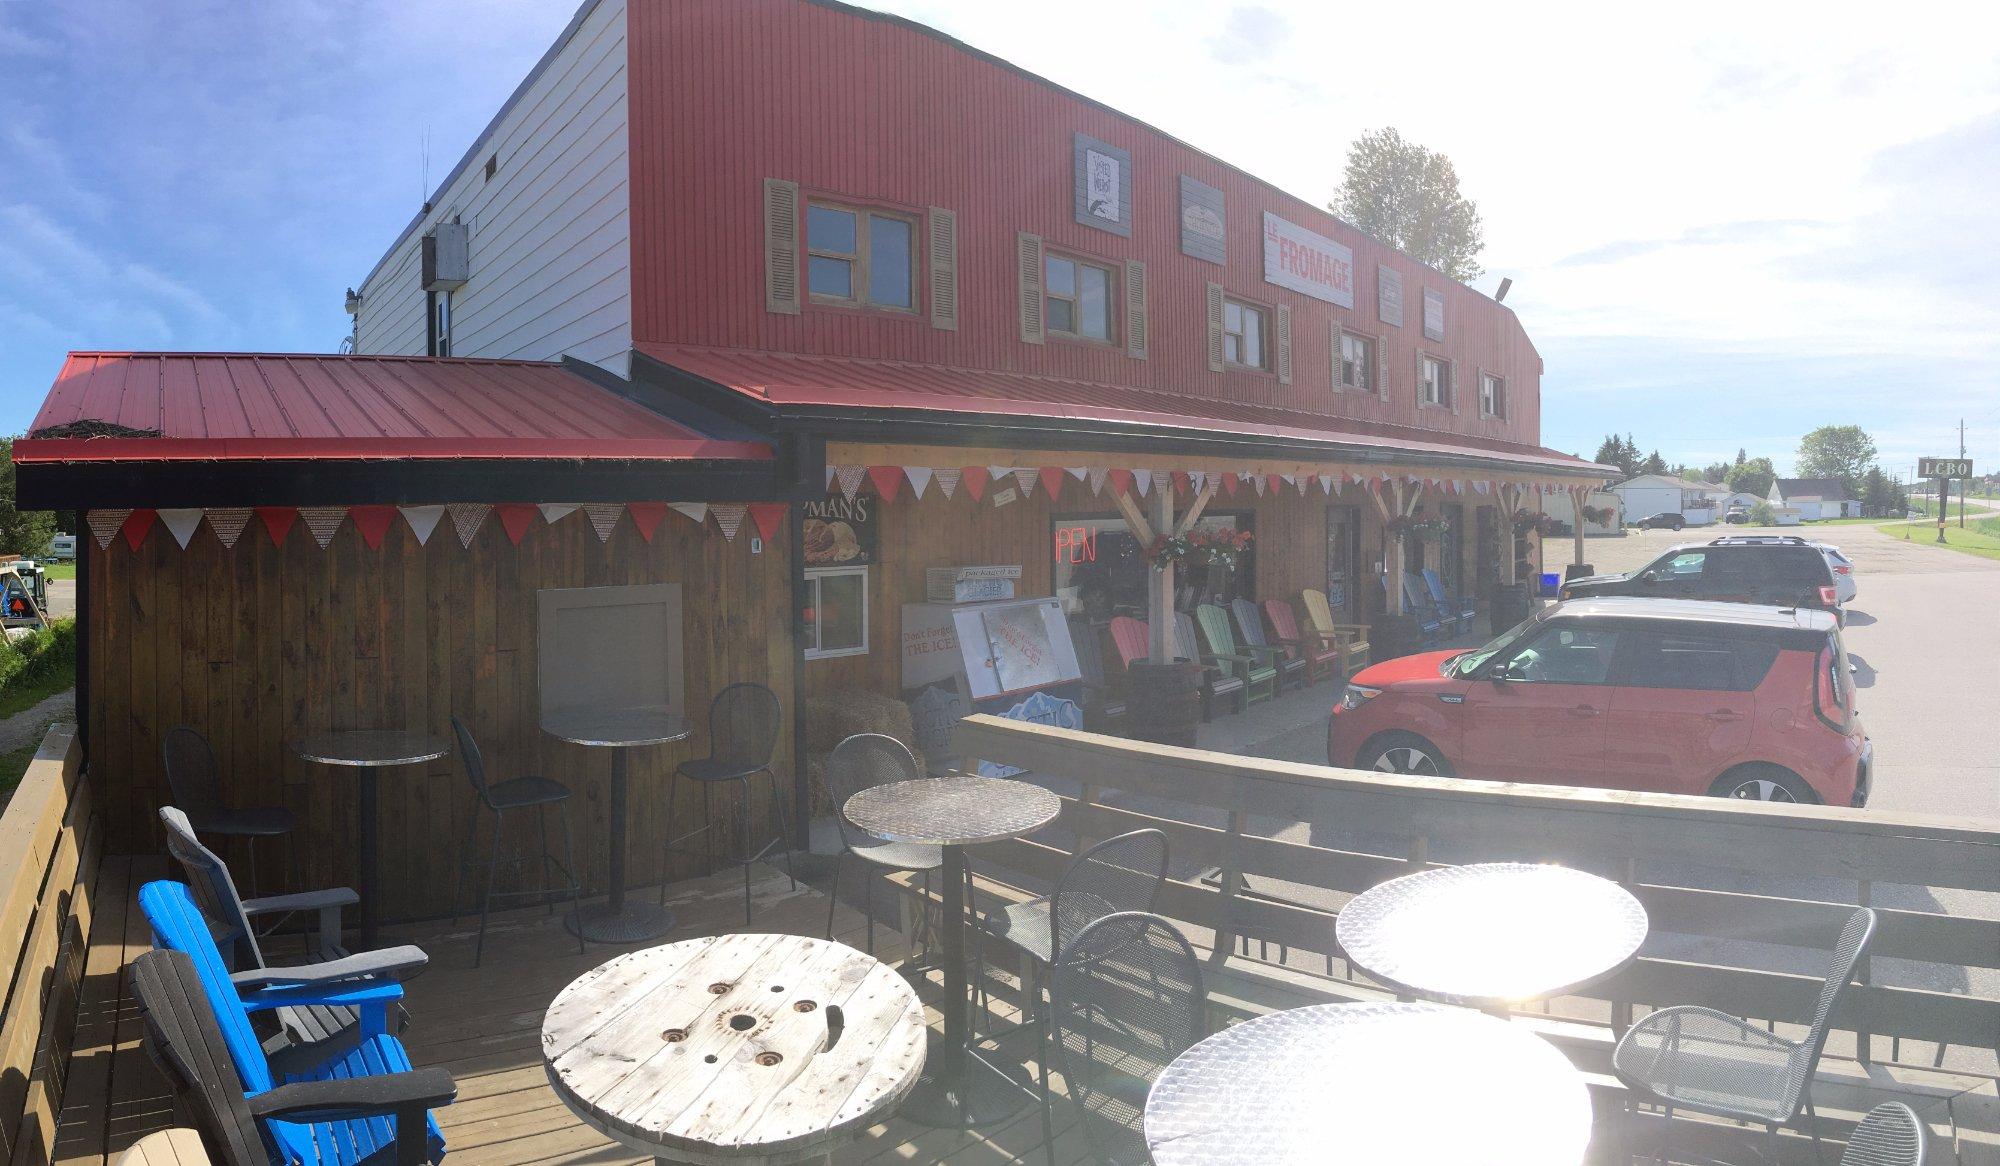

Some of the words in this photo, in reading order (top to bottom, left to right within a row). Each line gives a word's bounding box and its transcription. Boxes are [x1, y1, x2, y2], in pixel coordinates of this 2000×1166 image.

[1267, 221, 1278, 238] LE
[1280, 237, 1350, 293] FROMAGE
[1925, 462, 1968, 475] LCBO
[1055, 526, 1096, 564] PEN
[965, 568, 1006, 577] packaged
[904, 631, 926, 643] Don't
[905, 643, 931, 656] THE
